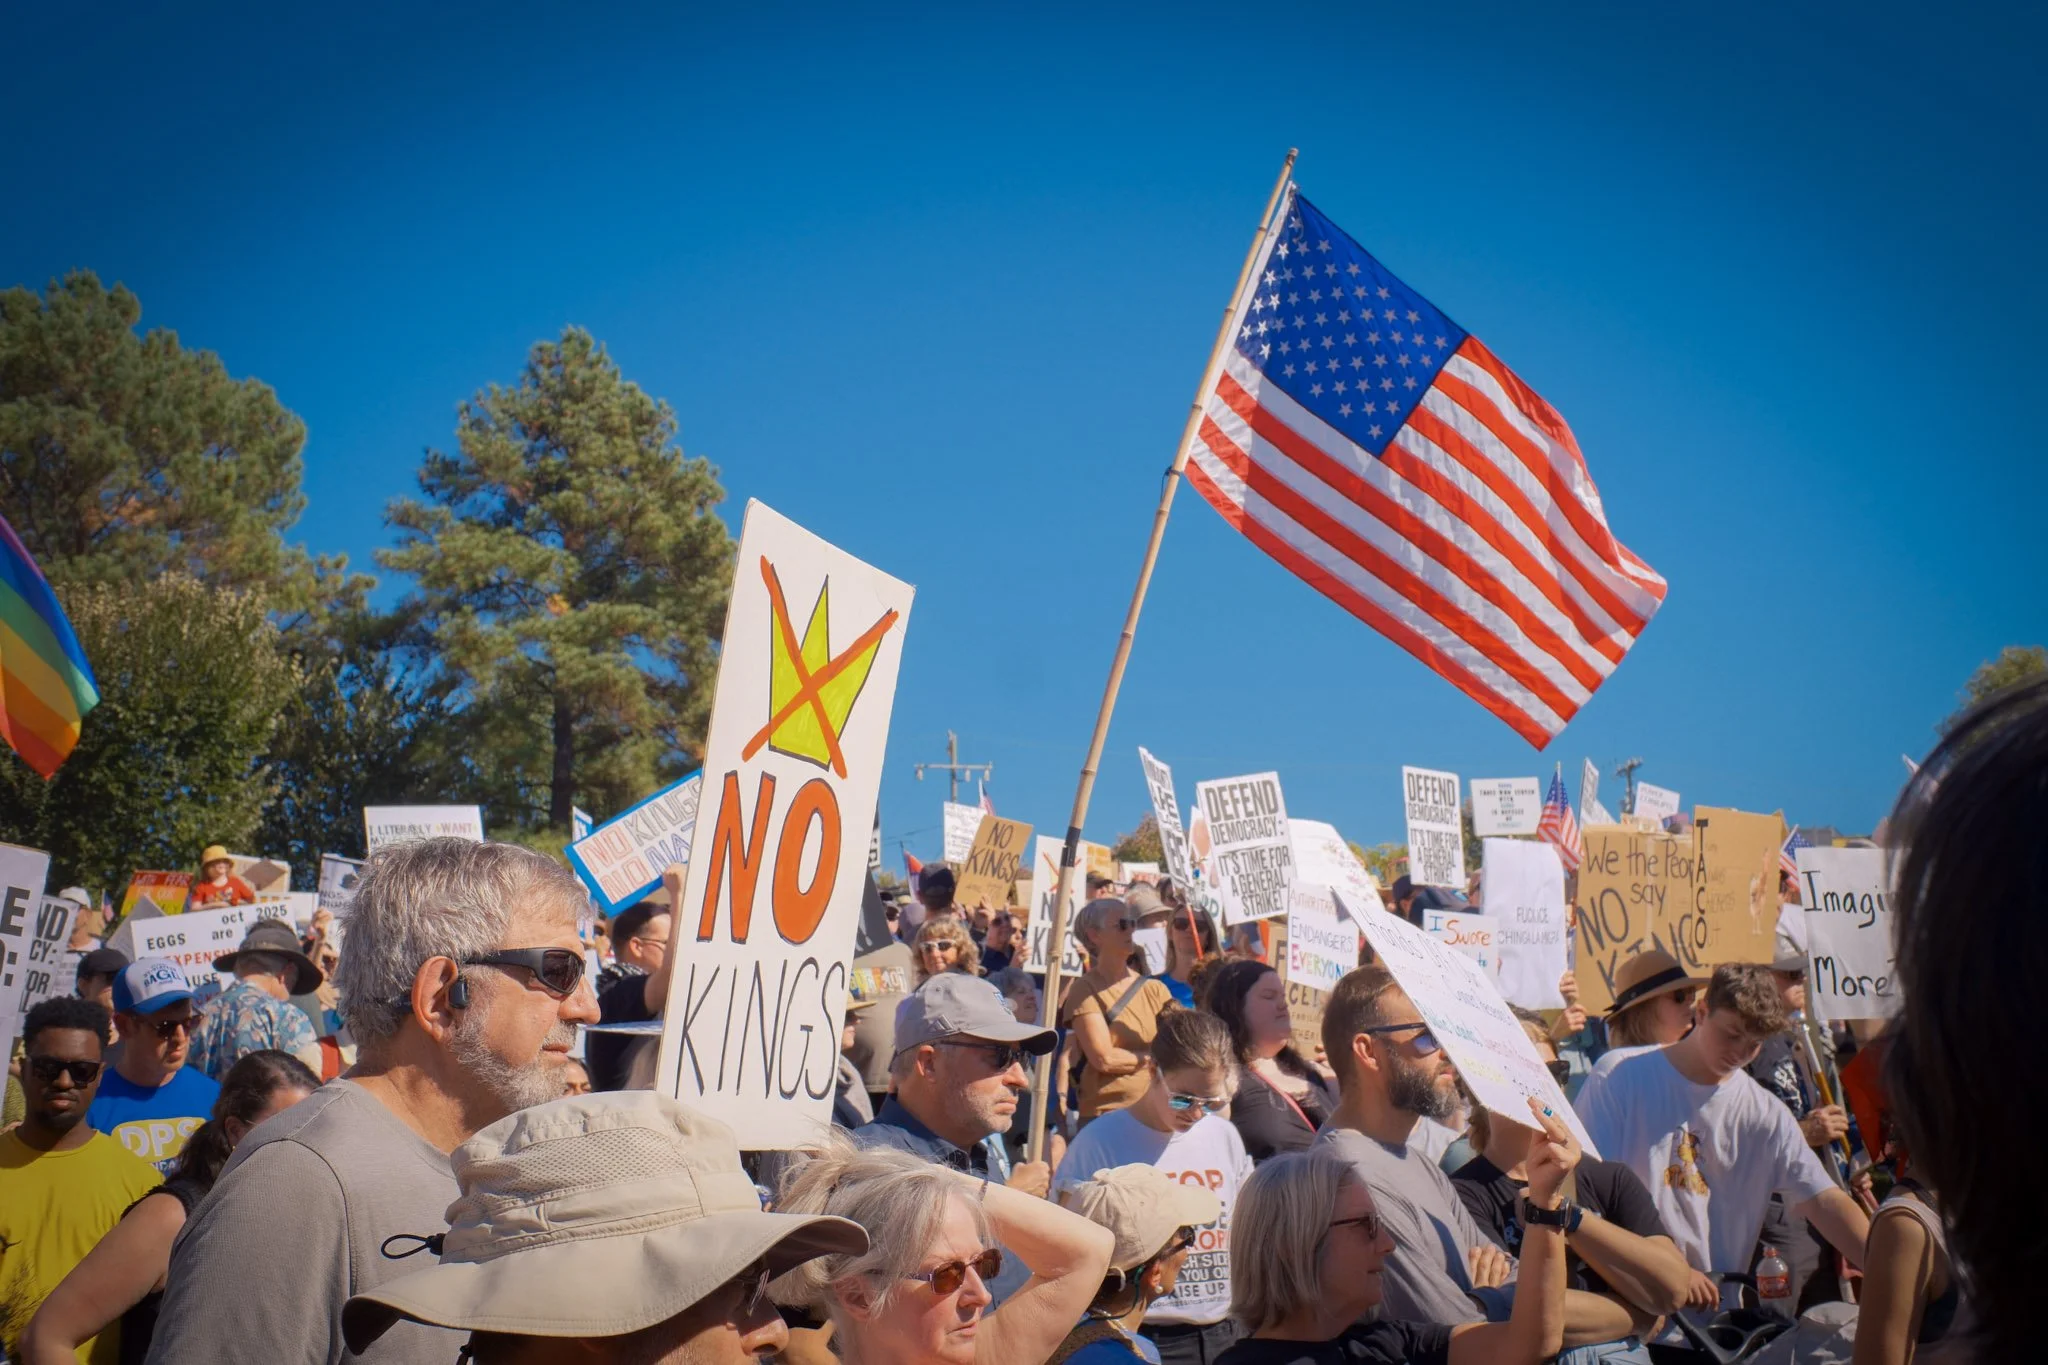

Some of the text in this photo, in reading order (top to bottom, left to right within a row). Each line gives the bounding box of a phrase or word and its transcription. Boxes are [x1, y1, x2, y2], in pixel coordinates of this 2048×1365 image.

[1204, 779, 1279, 823] DEFEND
[1406, 772, 1456, 807] DEFEND
[441, 822, 472, 834] WANT
[1407, 803, 1459, 826] DEMOCRACY:
[986, 821, 1014, 849] NO
[1210, 816, 1285, 846] DEMOCRACY:
[576, 823, 634, 875] NO
[696, 769, 842, 948] NO
[1218, 845, 1291, 877] IT'S TIME FOR
[1583, 835, 1620, 875] We
[1626, 836, 1660, 877] the
[600, 855, 654, 904] NO
[1230, 868, 1287, 897] A GENERAL
[221, 904, 288, 925] oct 2025
[1242, 891, 1284, 917] STRIKE!
[1630, 882, 1667, 917] say
[1291, 915, 1354, 954] ENDANGERS
[1428, 915, 1491, 946] I Swore
[1575, 887, 1629, 956] NO
[146, 929, 234, 951] EGGS are
[26, 969, 51, 995] OR
[674, 957, 845, 1101] KINGS
[1182, 1268, 1210, 1282] YOU
[1205, 1282, 1225, 1296] UP
